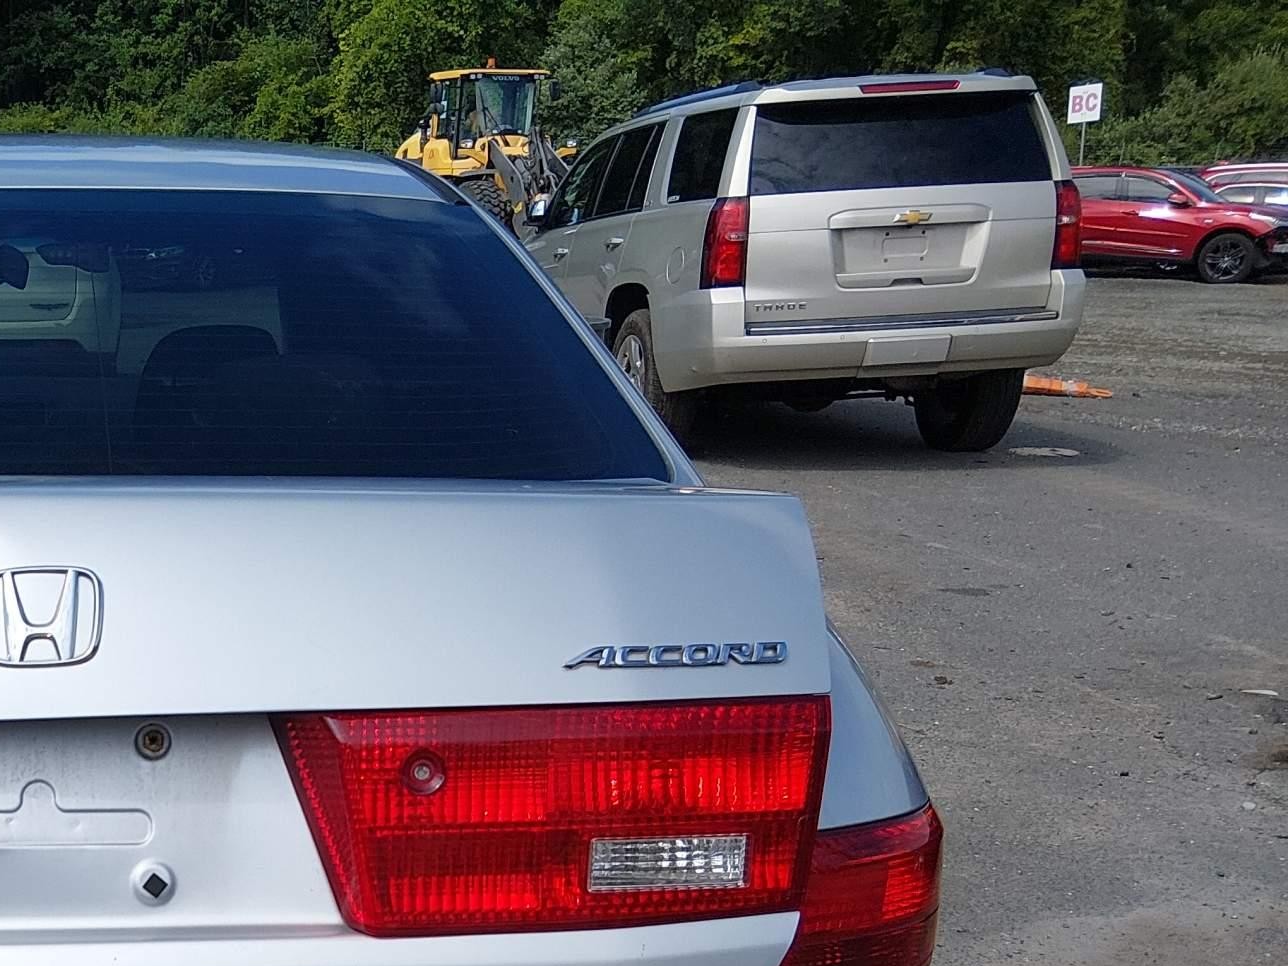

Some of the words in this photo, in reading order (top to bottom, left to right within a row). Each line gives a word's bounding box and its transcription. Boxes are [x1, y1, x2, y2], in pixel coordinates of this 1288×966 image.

[1072, 92, 1098, 113] BC
[753, 301, 808, 312] TAHOE
[562, 641, 789, 668] ACCORD
